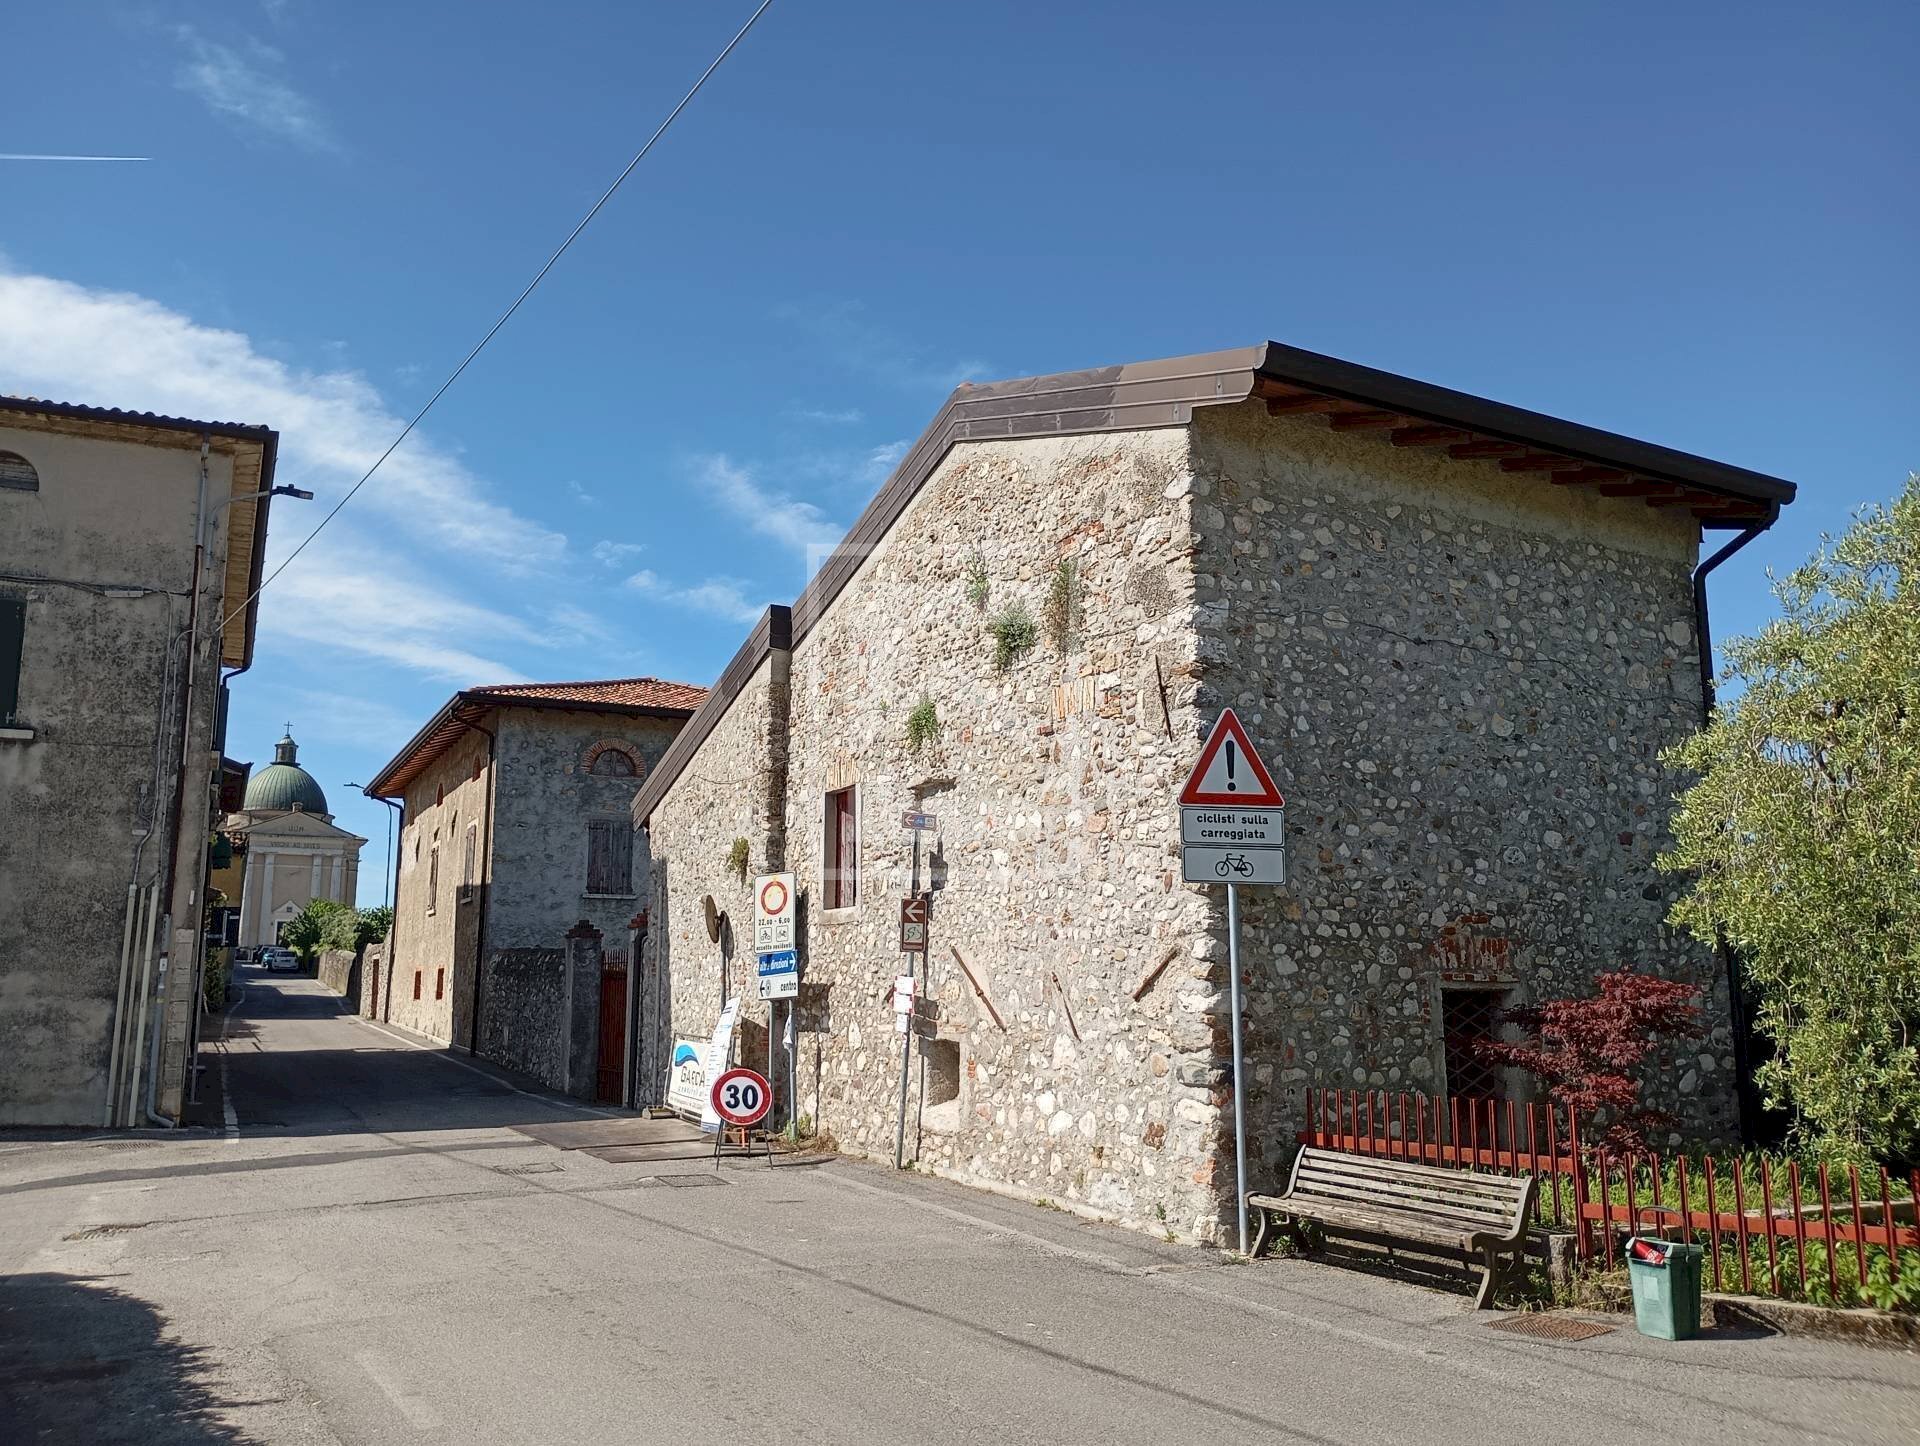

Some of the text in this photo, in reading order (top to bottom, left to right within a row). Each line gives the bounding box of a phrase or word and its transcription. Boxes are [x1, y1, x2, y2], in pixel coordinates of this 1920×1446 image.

[1196, 813, 1269, 825] ciclisti sulla
[1200, 828, 1266, 840] carreggiata
[770, 956, 789, 970] direzioni
[780, 980, 797, 992] centro
[725, 1084, 759, 1110] 30
